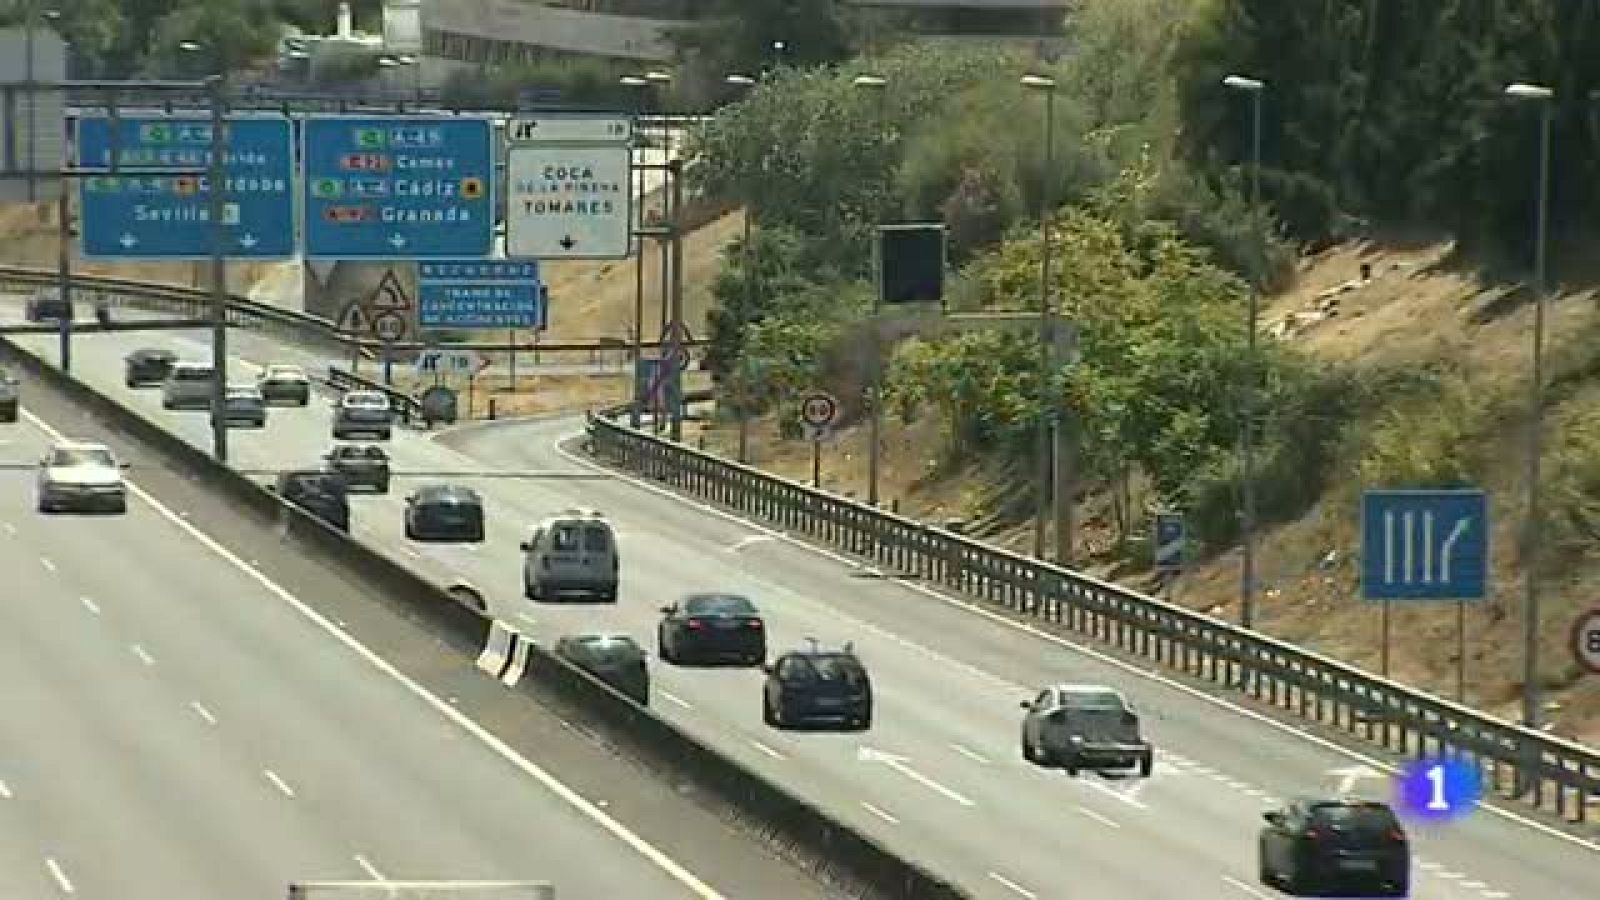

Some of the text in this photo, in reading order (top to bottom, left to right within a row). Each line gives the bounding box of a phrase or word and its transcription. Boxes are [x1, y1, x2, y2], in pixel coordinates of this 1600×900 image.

[199, 177, 285, 192] Crdoba
[134, 204, 209, 221] Sevilla
[381, 205, 472, 222] Granada
[524, 199, 614, 216] TOMARES
